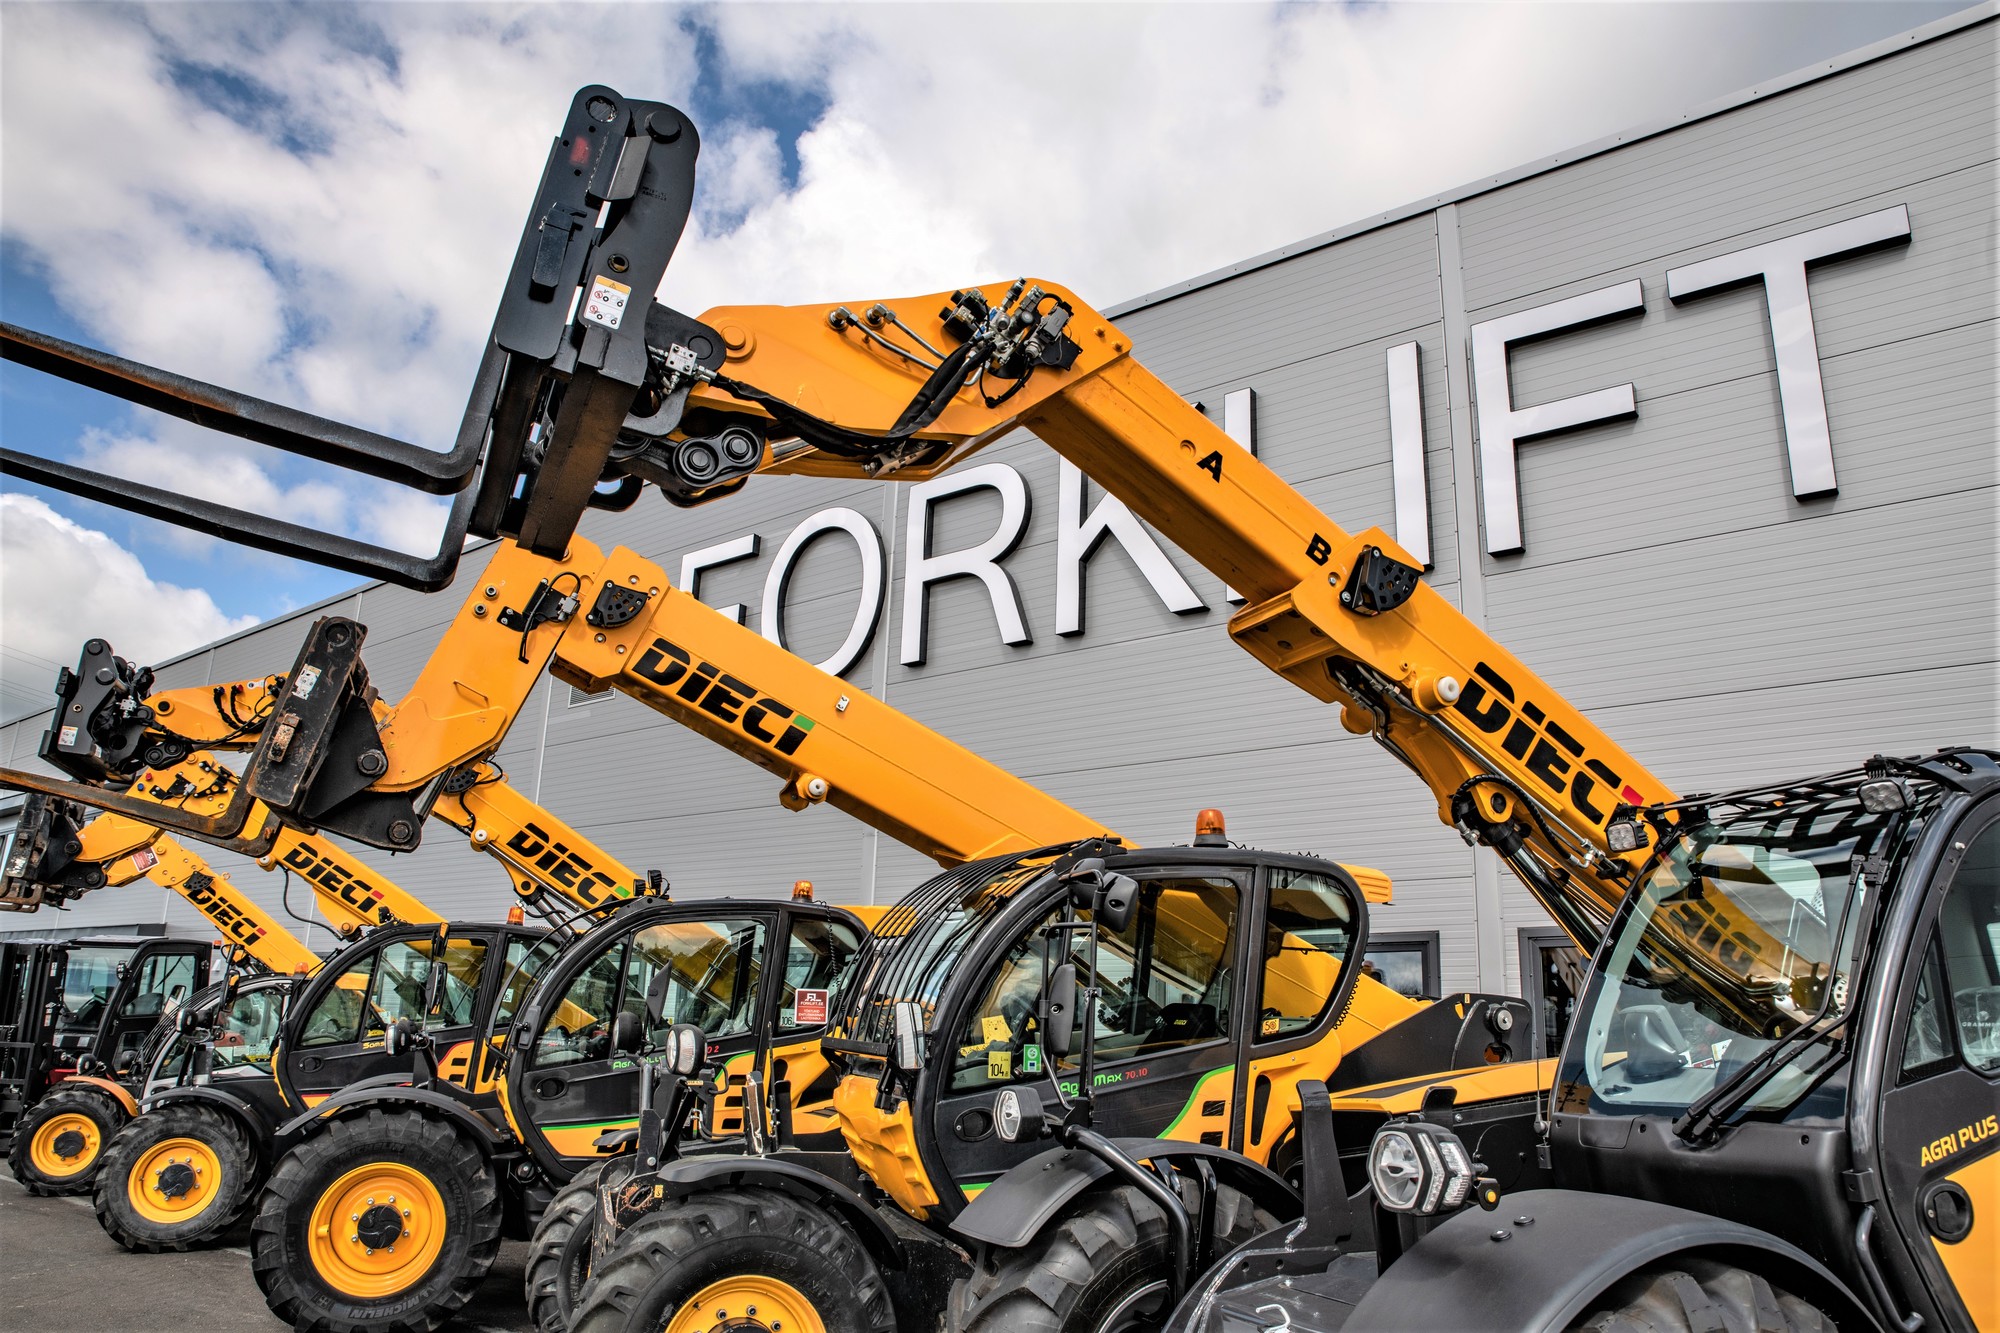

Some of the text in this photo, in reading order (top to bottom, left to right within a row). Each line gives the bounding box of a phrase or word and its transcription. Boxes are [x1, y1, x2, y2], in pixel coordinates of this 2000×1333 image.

[1196, 450, 1223, 483] A
[1305, 532, 1332, 566] B
[632, 637, 816, 756] DIECI
[1452, 661, 1645, 825] DIEC
[282, 841, 385, 913] DIECI
[990, 1063, 1004, 1077] 104
[1125, 1067, 1148, 1080] 70.10
[1920, 1114, 2000, 1168] AGRI PLUS
[348, 1294, 421, 1320] MICHELIN
